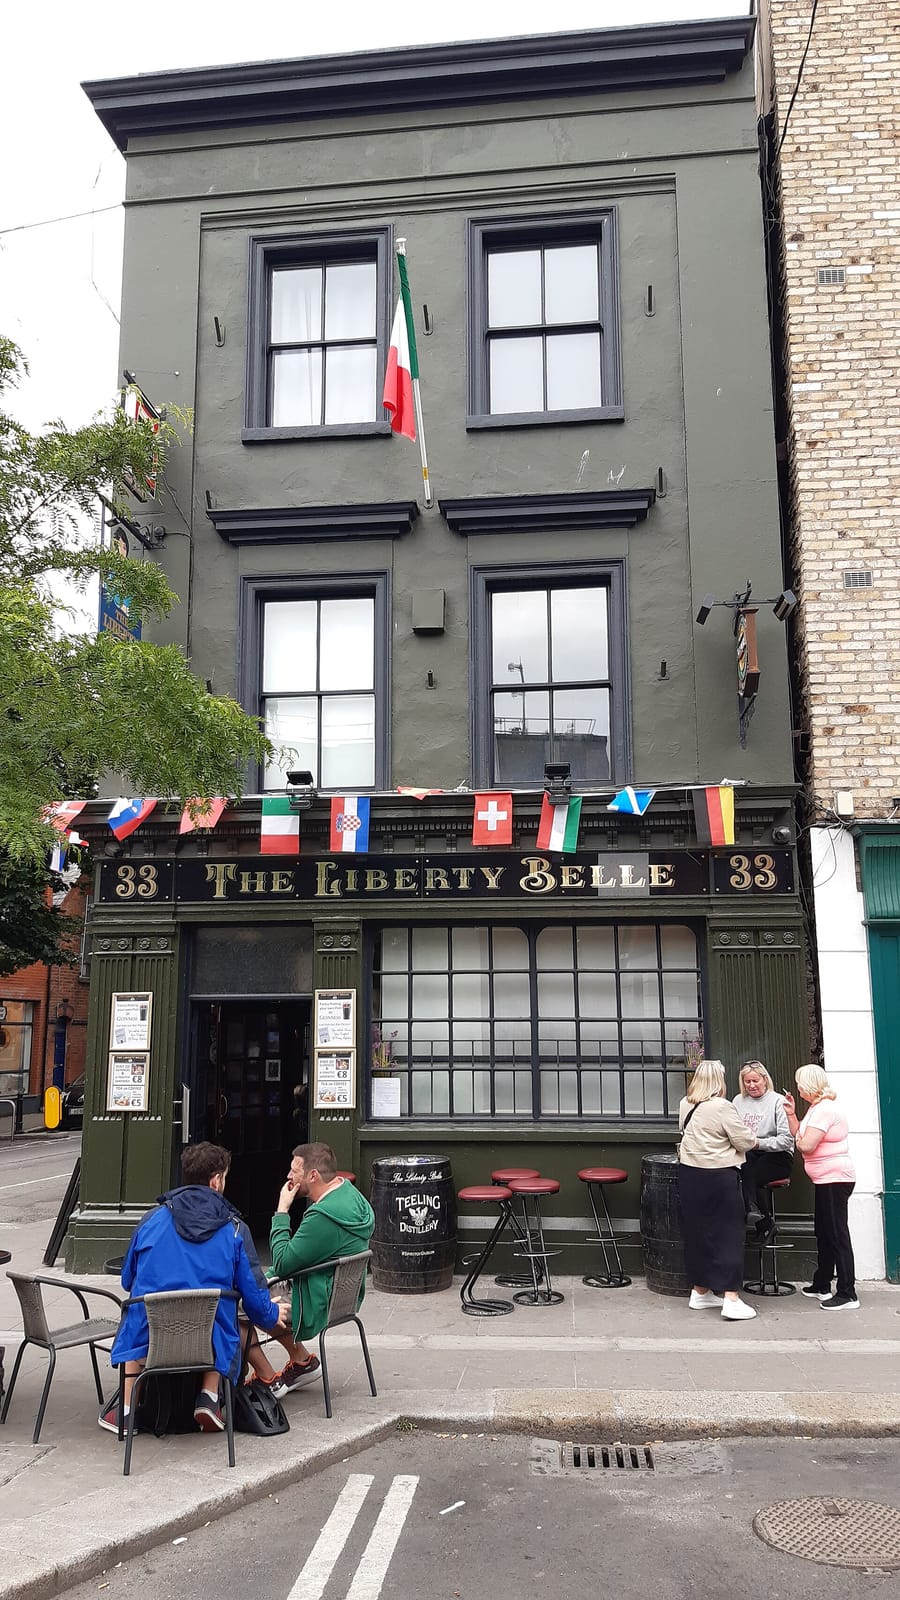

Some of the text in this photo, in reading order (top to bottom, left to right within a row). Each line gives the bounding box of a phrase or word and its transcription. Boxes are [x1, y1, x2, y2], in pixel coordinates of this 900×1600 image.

[204, 857, 676, 898] THE LIBERTY BELLE
[729, 854, 778, 889] 33
[115, 864, 159, 898] 33
[132, 1075, 142, 1083] €8
[337, 1070, 347, 1078] €8
[337, 1094, 347, 1103] €5
[743, 1112, 764, 1122] Enjoy
[391, 1172, 403, 1183] The
[404, 1172, 427, 1184] Liberty
[395, 1194, 440, 1212] TEELING
[399, 1219, 439, 1234] DISTILLERY
